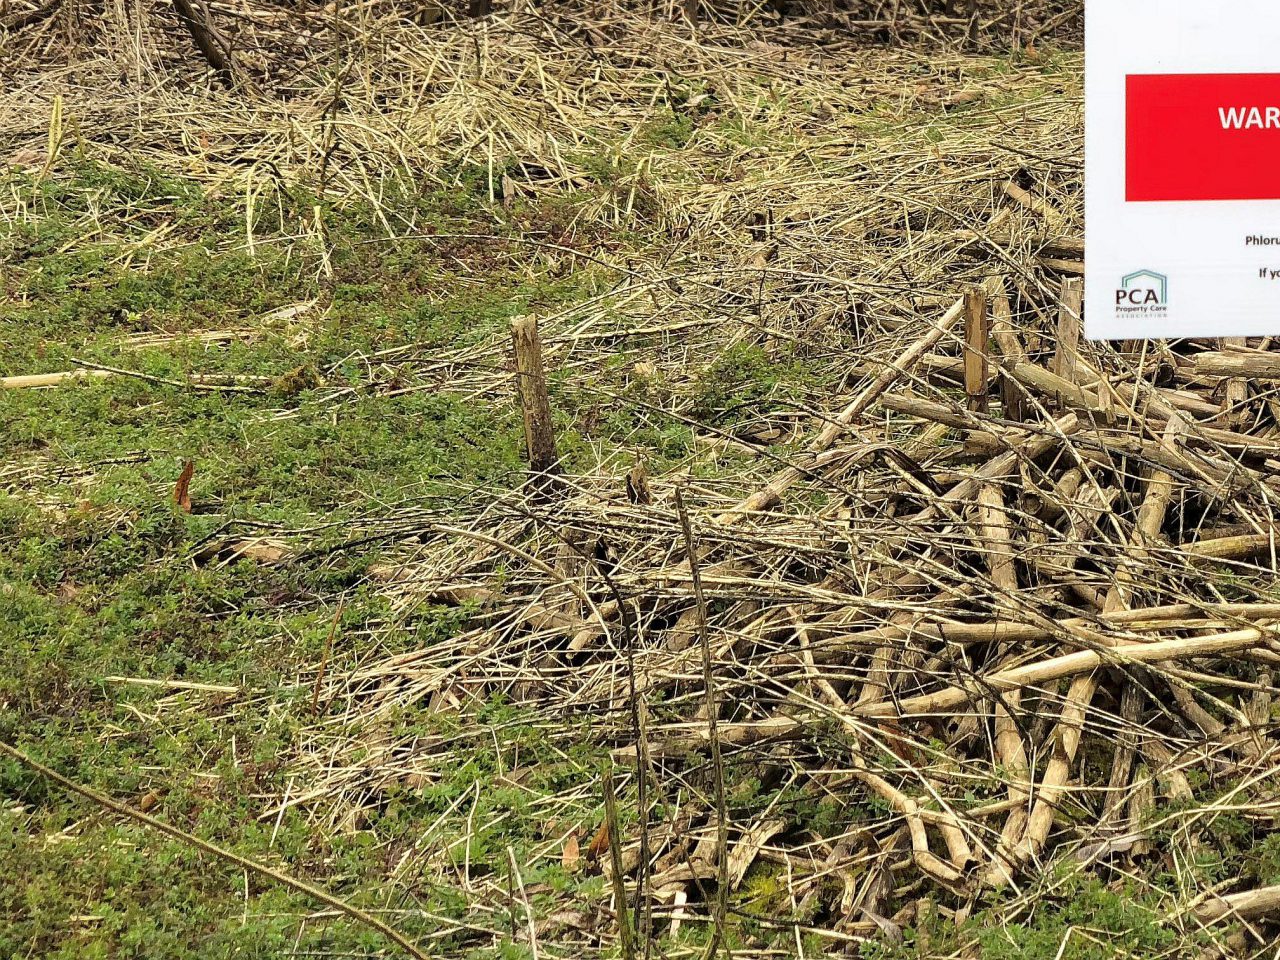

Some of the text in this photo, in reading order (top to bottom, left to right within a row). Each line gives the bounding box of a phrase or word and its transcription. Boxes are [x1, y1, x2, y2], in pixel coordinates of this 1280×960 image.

[1259, 267, 1268, 277] If
[1116, 289, 1159, 304] PCA
[1115, 304, 1167, 313] Property Care
